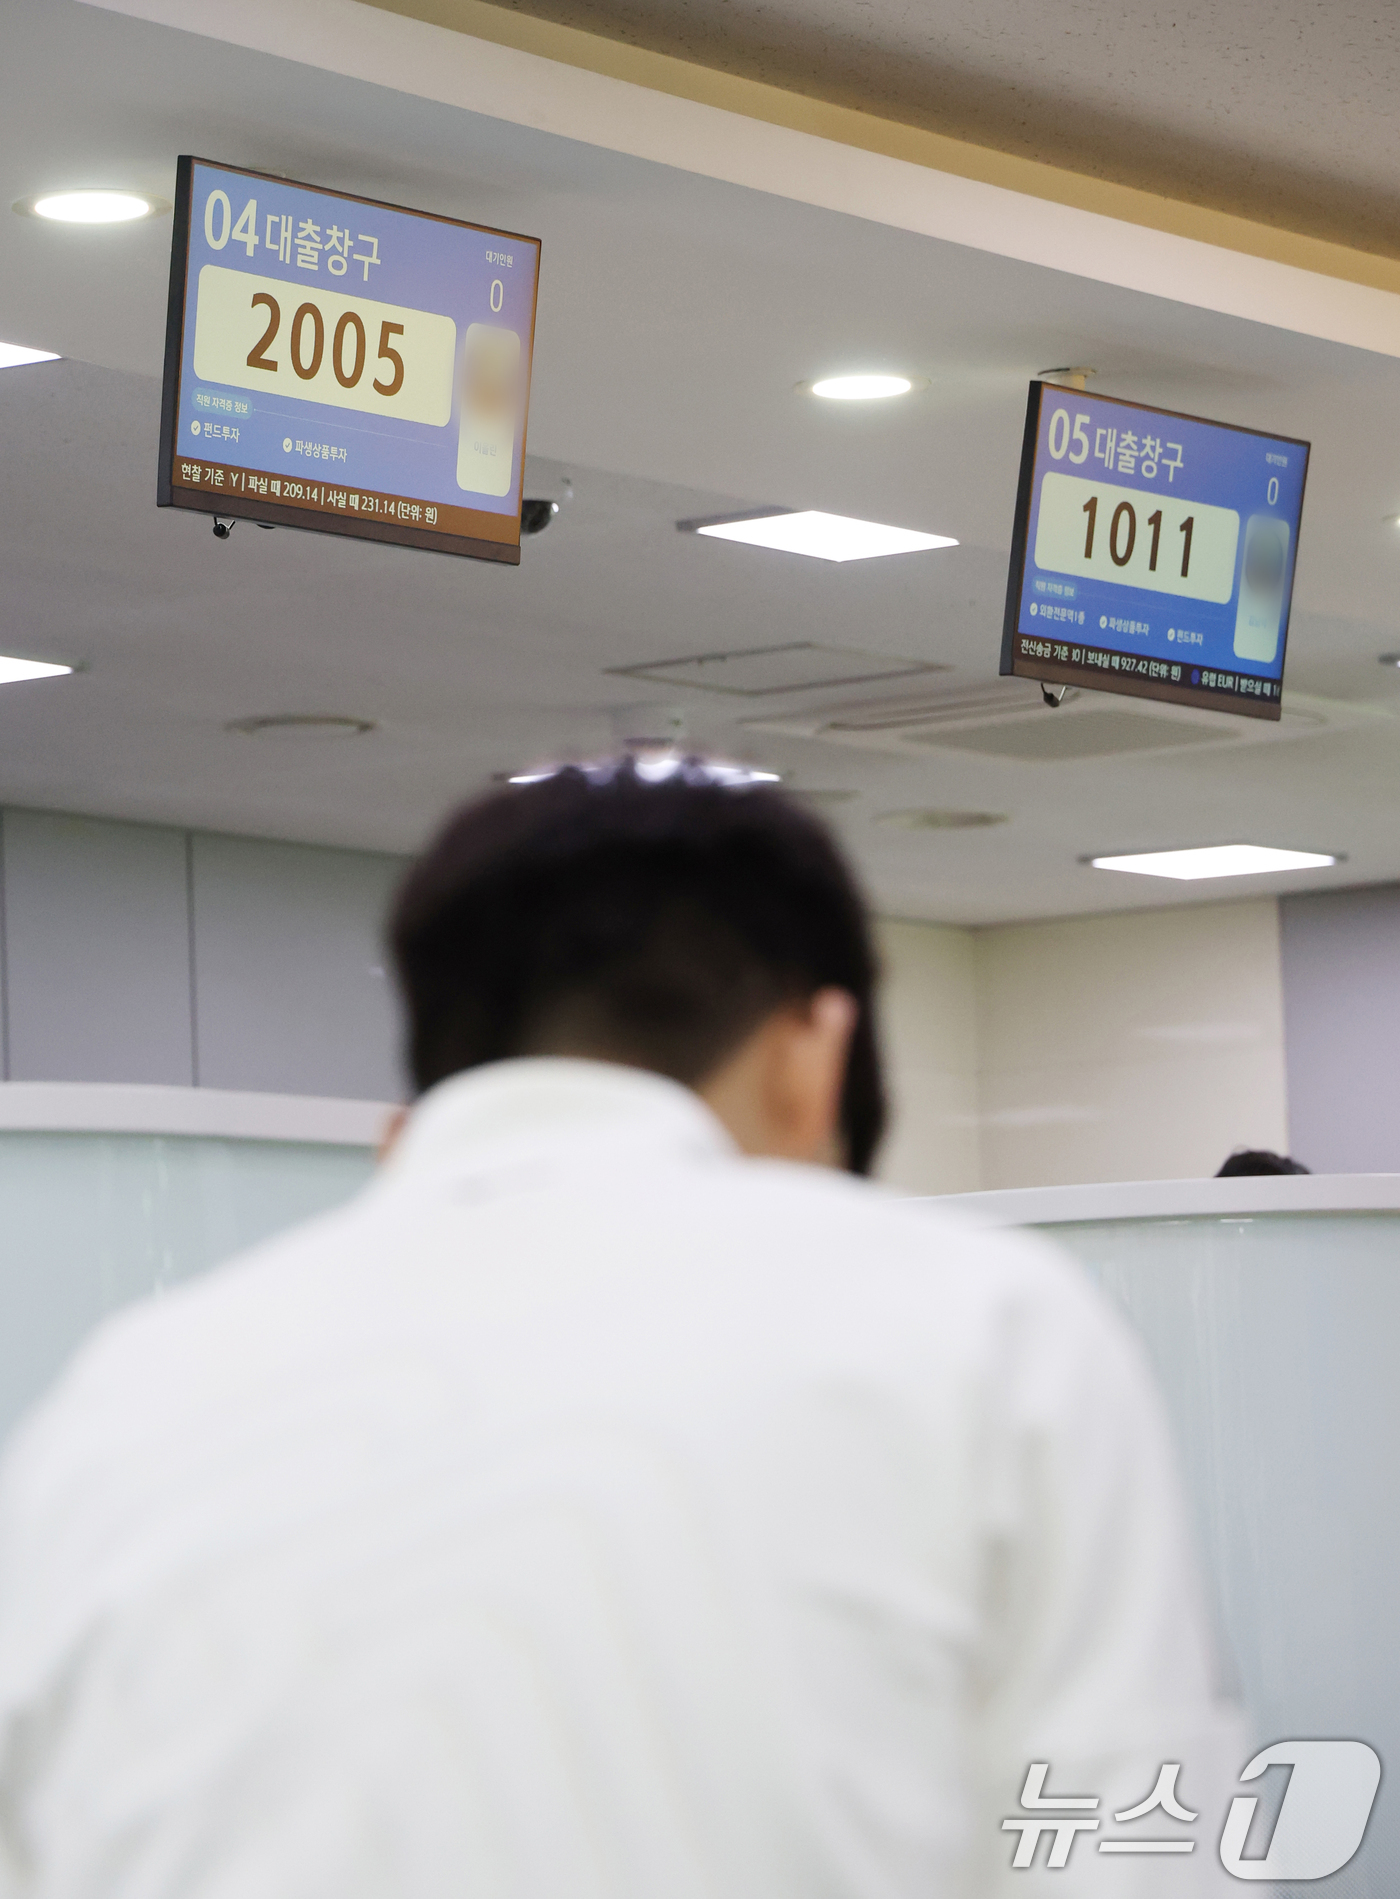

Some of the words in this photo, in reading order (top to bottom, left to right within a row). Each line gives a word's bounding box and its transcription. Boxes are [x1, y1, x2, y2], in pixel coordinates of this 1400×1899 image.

[204, 189, 259, 257] 04
[265, 214, 381, 281] 대출창구
[485, 250, 514, 268] 대기인원
[490, 279, 504, 313] 0
[246, 292, 404, 396] 2005
[196, 393, 211, 407] 직원
[211, 397, 233, 412] 자격증
[234, 401, 248, 414] 정보
[203, 422, 240, 443] 펀드투자
[295, 440, 348, 463] 파생상품투자
[1048, 408, 1090, 464] 05
[1094, 427, 1184, 483] 대출창구
[181, 462, 202, 483] 현찰
[204, 468, 225, 487] 기준
[247, 475, 268, 495] 파실
[270, 480, 281, 497] 때
[283, 481, 318, 502] 209.14
[326, 490, 347, 509] 사실
[349, 494, 359, 511] 때
[361, 496, 395, 516] 231.14
[397, 500, 422, 521] (단위:
[424, 506, 438, 526] 원)
[1267, 477, 1279, 506] 0
[1082, 496, 1194, 578] 1011
[1021, 639, 1052, 659] 전신송금
[1053, 644, 1069, 661] 기준
[1111, 655, 1120, 671] 때
[1120, 656, 1148, 674] 927.42
[1217, 671, 1234, 690] EUR
